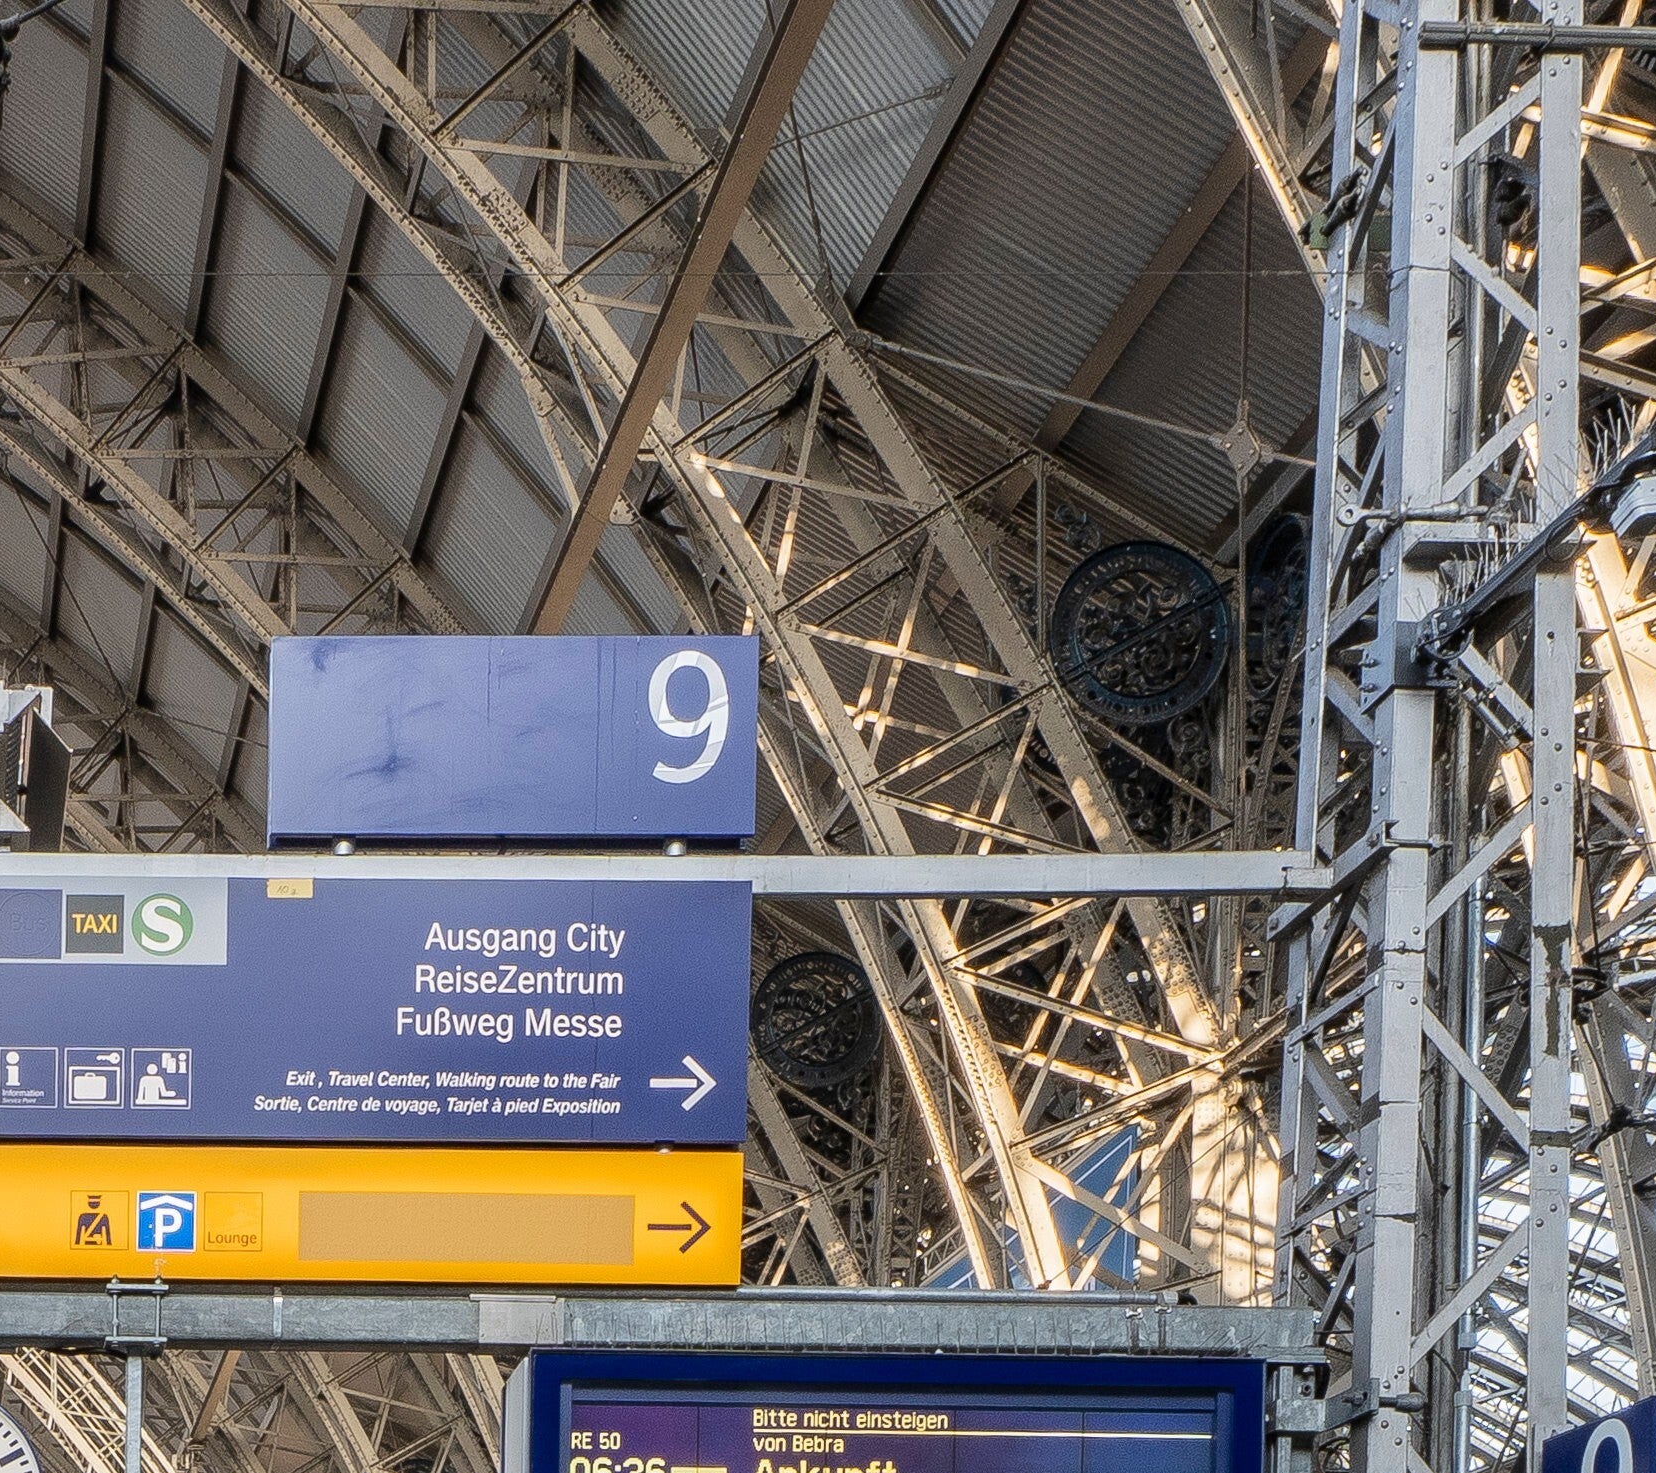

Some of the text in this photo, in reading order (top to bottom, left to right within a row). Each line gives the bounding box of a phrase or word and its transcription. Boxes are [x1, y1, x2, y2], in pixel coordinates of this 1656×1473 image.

[647, 650, 730, 785] 9
[72, 913, 118, 934] TAXI
[141, 897, 184, 951] S
[424, 922, 626, 958] Ausgang City
[415, 963, 624, 995] ReiseZentrum
[396, 1006, 622, 1043] Fußweg Messe
[286, 1071, 621, 1090] Exit Travel Center, Walking route to the Fair
[1, 1089, 45, 1098] Information
[253, 1095, 621, 1116] Sortie, Centre de voyage, Tarjet à pied Exposition
[154, 1207, 183, 1248] P
[207, 1231, 258, 1247] Lounge
[752, 1409, 948, 1432] Bitte nicht einsteigen
[571, 1432, 621, 1451] RE 50
[752, 1435, 845, 1453] von Bebra
